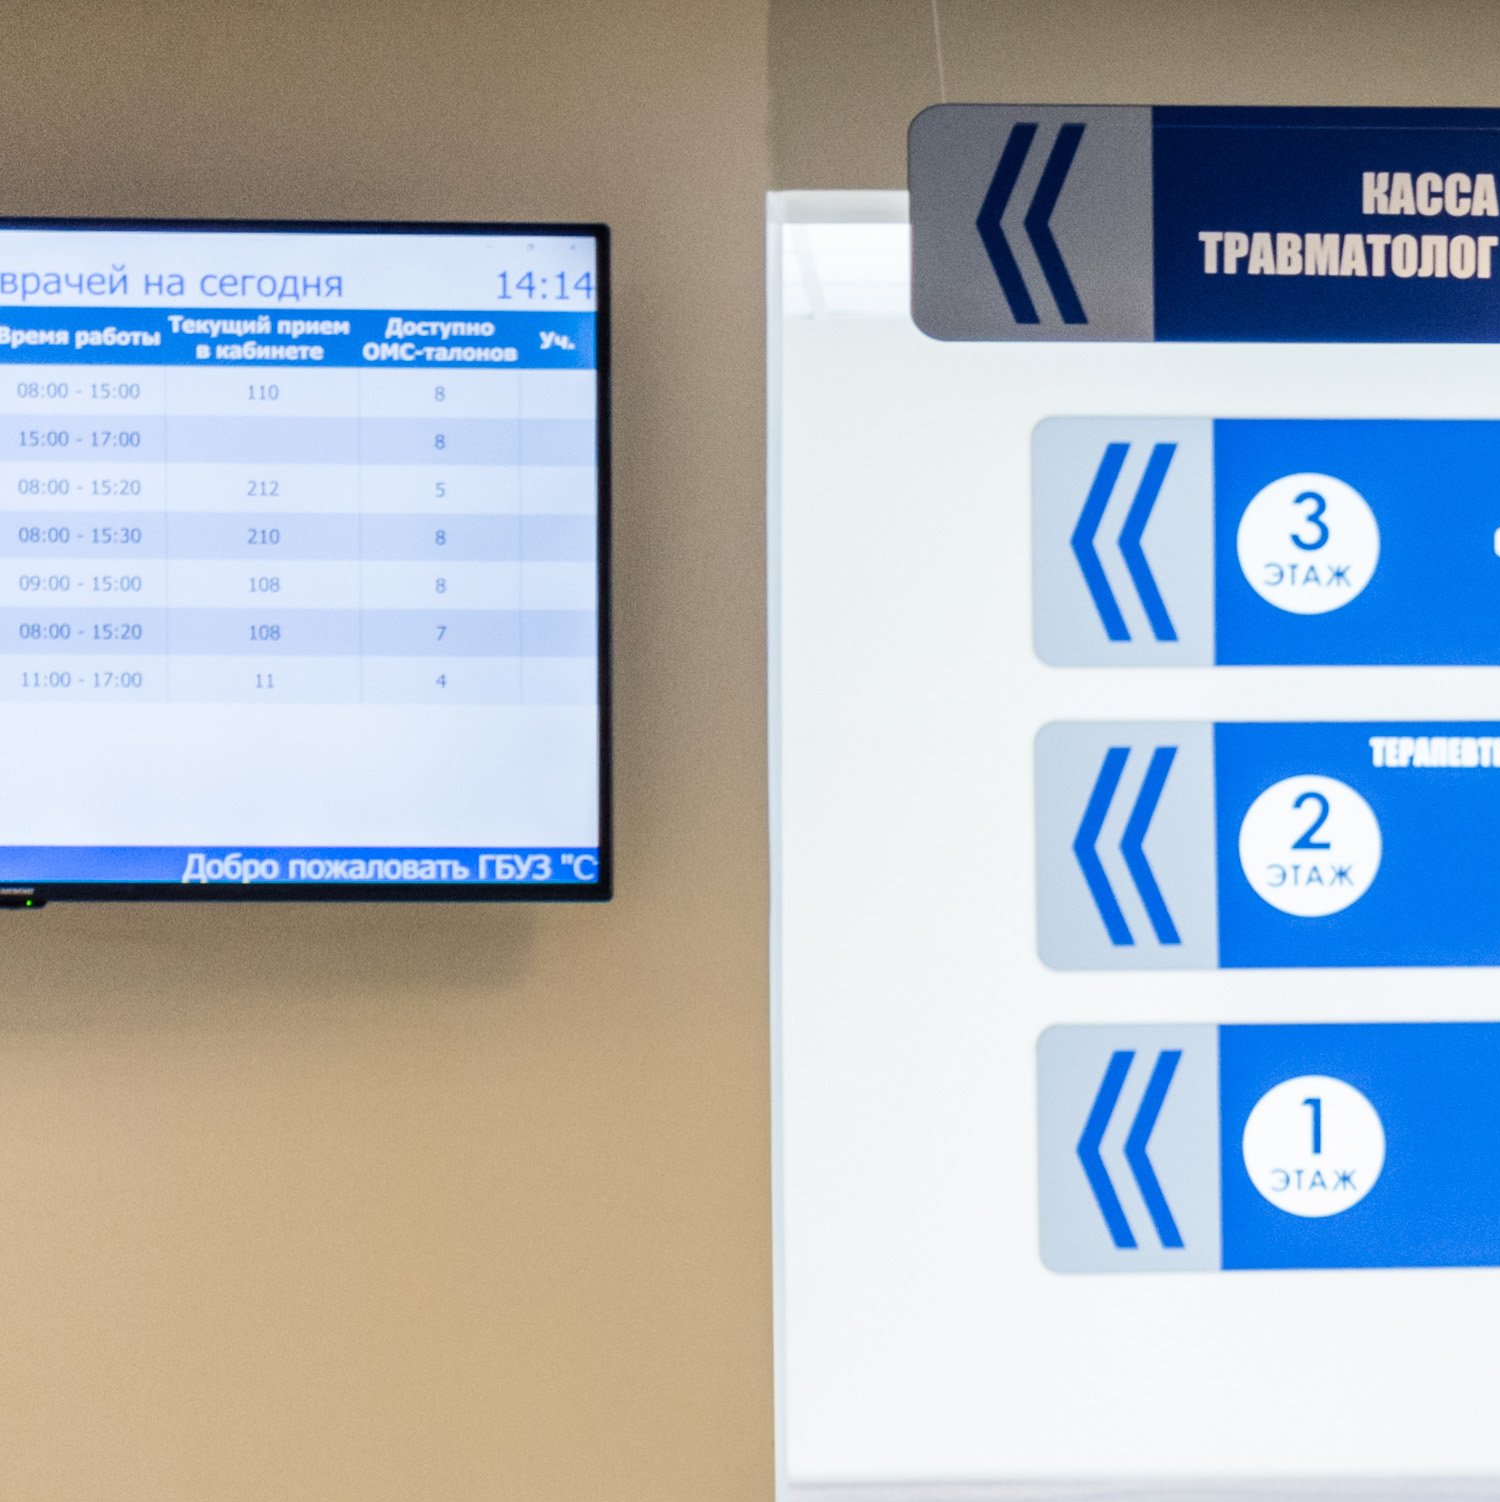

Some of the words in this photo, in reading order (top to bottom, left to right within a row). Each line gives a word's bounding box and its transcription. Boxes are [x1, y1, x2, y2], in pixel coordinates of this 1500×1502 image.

[1362, 172, 1499, 216] КАССА
[1198, 231, 1498, 279] ТРАВМАТОЛОГ
[1, 265, 128, 301] врачей
[144, 272, 186, 297] на
[201, 272, 343, 302] сегодня
[496, 271, 594, 300] 14:14
[168, 315, 270, 336] Текущий
[276, 319, 349, 337] прием
[386, 318, 494, 340] Доступно
[0, 326, 69, 348] Время
[75, 327, 160, 348] работы
[540, 332, 574, 352] Уч.
[196, 345, 210, 359] в
[216, 342, 324, 360] кабинете
[363, 344, 518, 362] ОМС-талонов
[17, 383, 68, 399] 08:00
[90, 384, 140, 400] 15:00
[248, 386, 278, 400] 110
[434, 386, 445, 402] 8
[19, 431, 68, 448] 15:00
[90, 432, 140, 448] 17:00
[434, 434, 445, 450] 8
[18, 479, 69, 496] 08:00
[91, 480, 140, 496] 15:20
[248, 480, 278, 497] 212
[435, 482, 445, 498] 5
[1291, 492, 1329, 551] 3
[19, 527, 69, 544] 08:00
[92, 528, 141, 544] 15:30
[248, 528, 280, 545] 210
[435, 530, 446, 546] 8
[1266, 563, 1350, 586] ЭТАЖ
[19, 575, 70, 592] 09:00
[92, 576, 142, 592] 15:00
[249, 576, 280, 593] 108
[436, 578, 446, 594] 8
[19, 624, 70, 640] 08:00
[92, 624, 142, 640] 15:20
[249, 624, 280, 641] 108
[436, 626, 446, 642] 7
[21, 671, 70, 688] 11:00
[93, 671, 142, 688] 17:00
[256, 672, 274, 688] 11
[435, 674, 446, 689] 4
[1291, 792, 1330, 850] 2
[183, 854, 278, 882] Добро
[289, 859, 469, 882] пожаловать
[479, 855, 552, 879] ГБУЗ
[1269, 864, 1352, 887] ЭТАЖ
[1302, 1098, 1321, 1154] 1
[1273, 1169, 1355, 1191] ЭТАЖ
